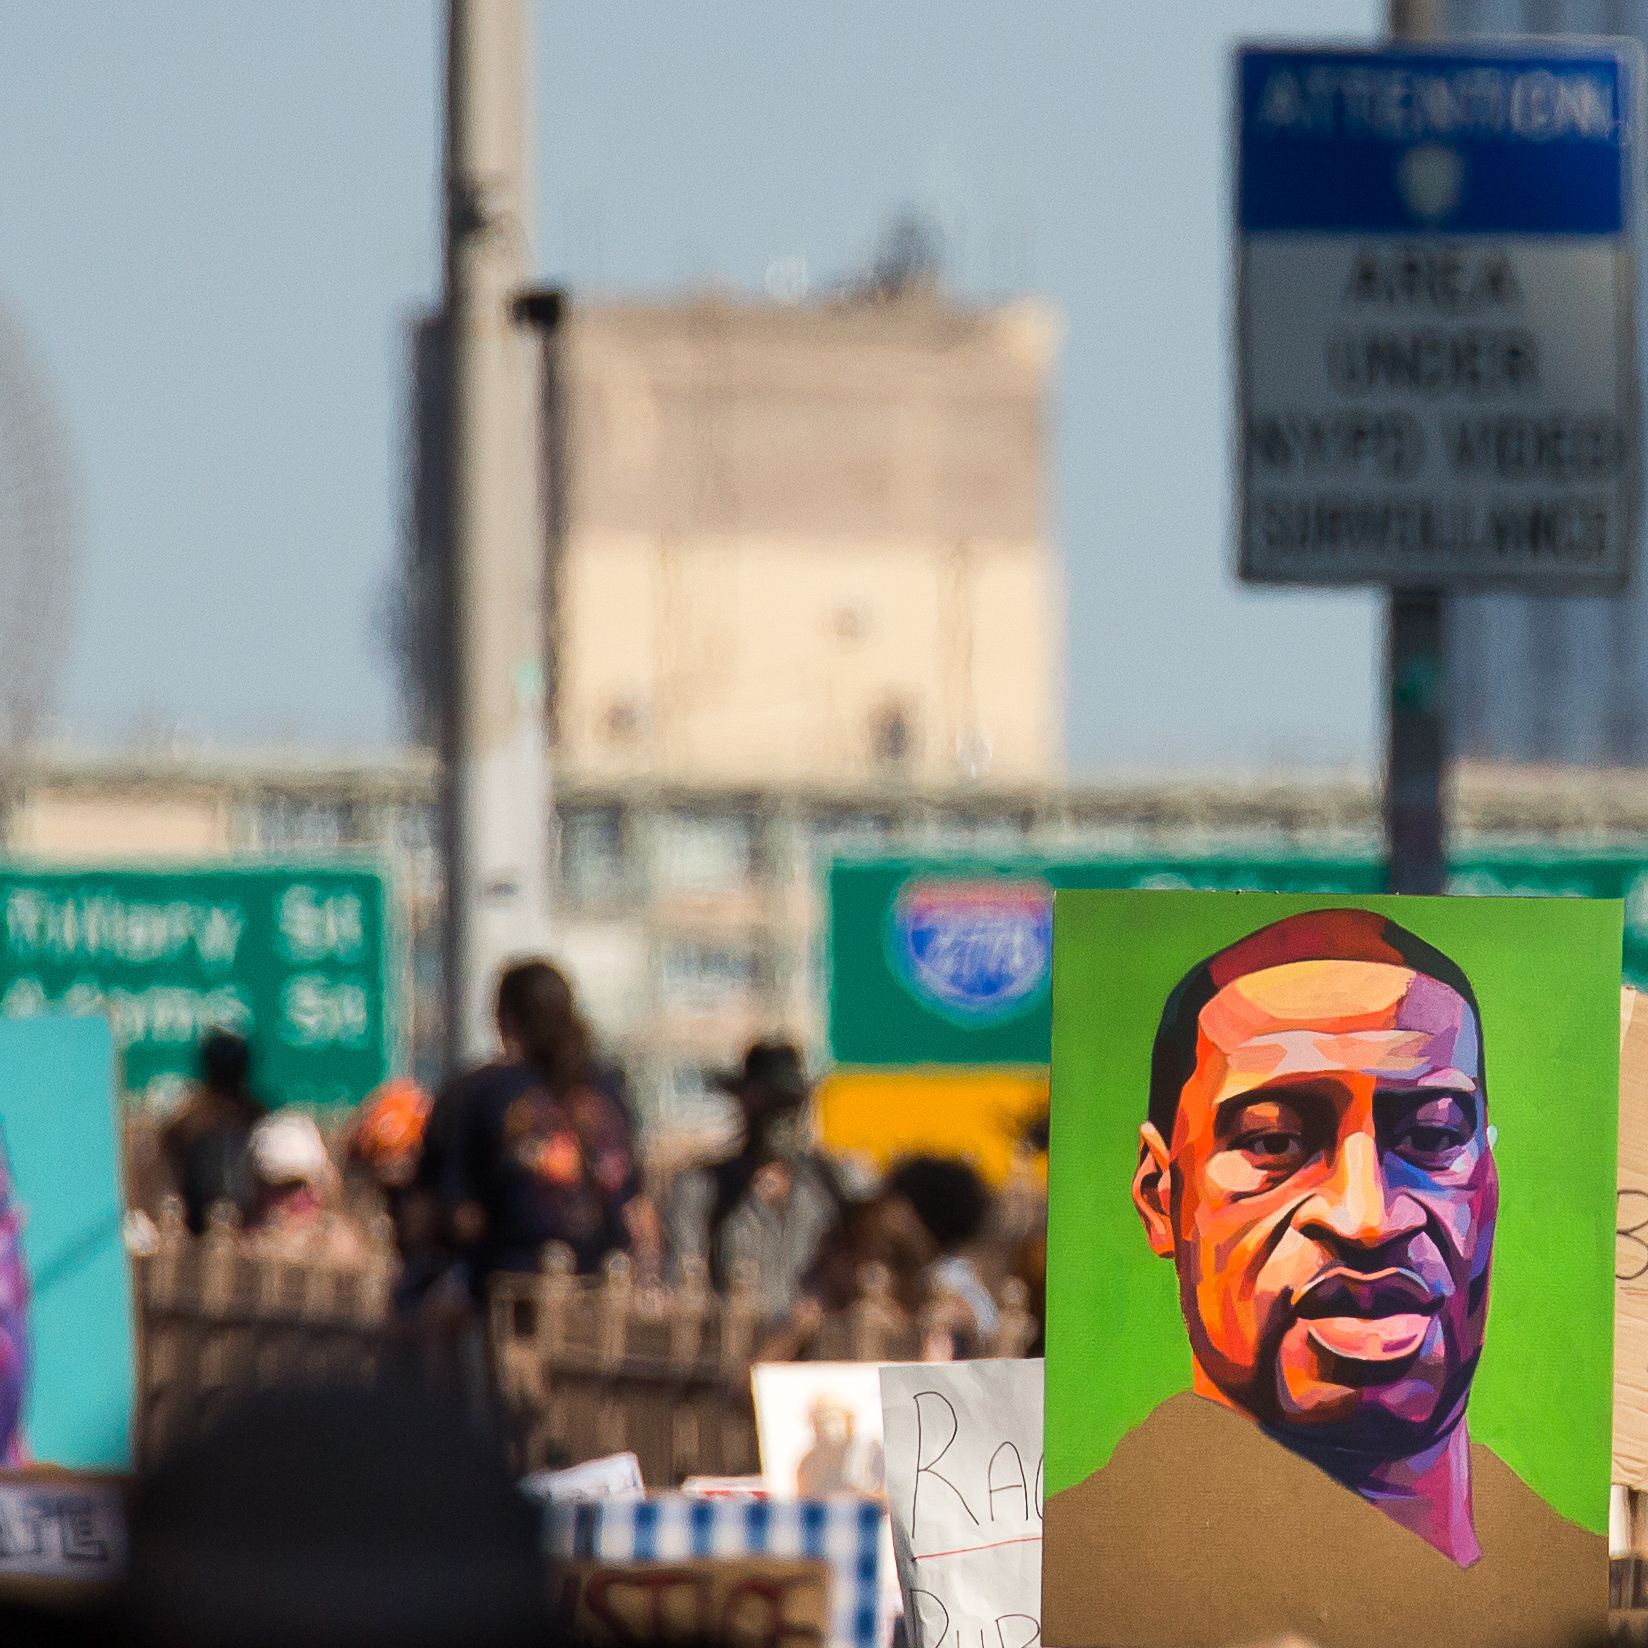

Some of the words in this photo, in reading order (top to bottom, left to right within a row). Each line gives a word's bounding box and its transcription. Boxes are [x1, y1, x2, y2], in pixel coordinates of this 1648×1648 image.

[1260, 66, 1615, 142] ATTENTION
[1346, 248, 1525, 304] AREA
[1326, 328, 1543, 396] UNDER
[911, 1390, 1044, 1540] RA
